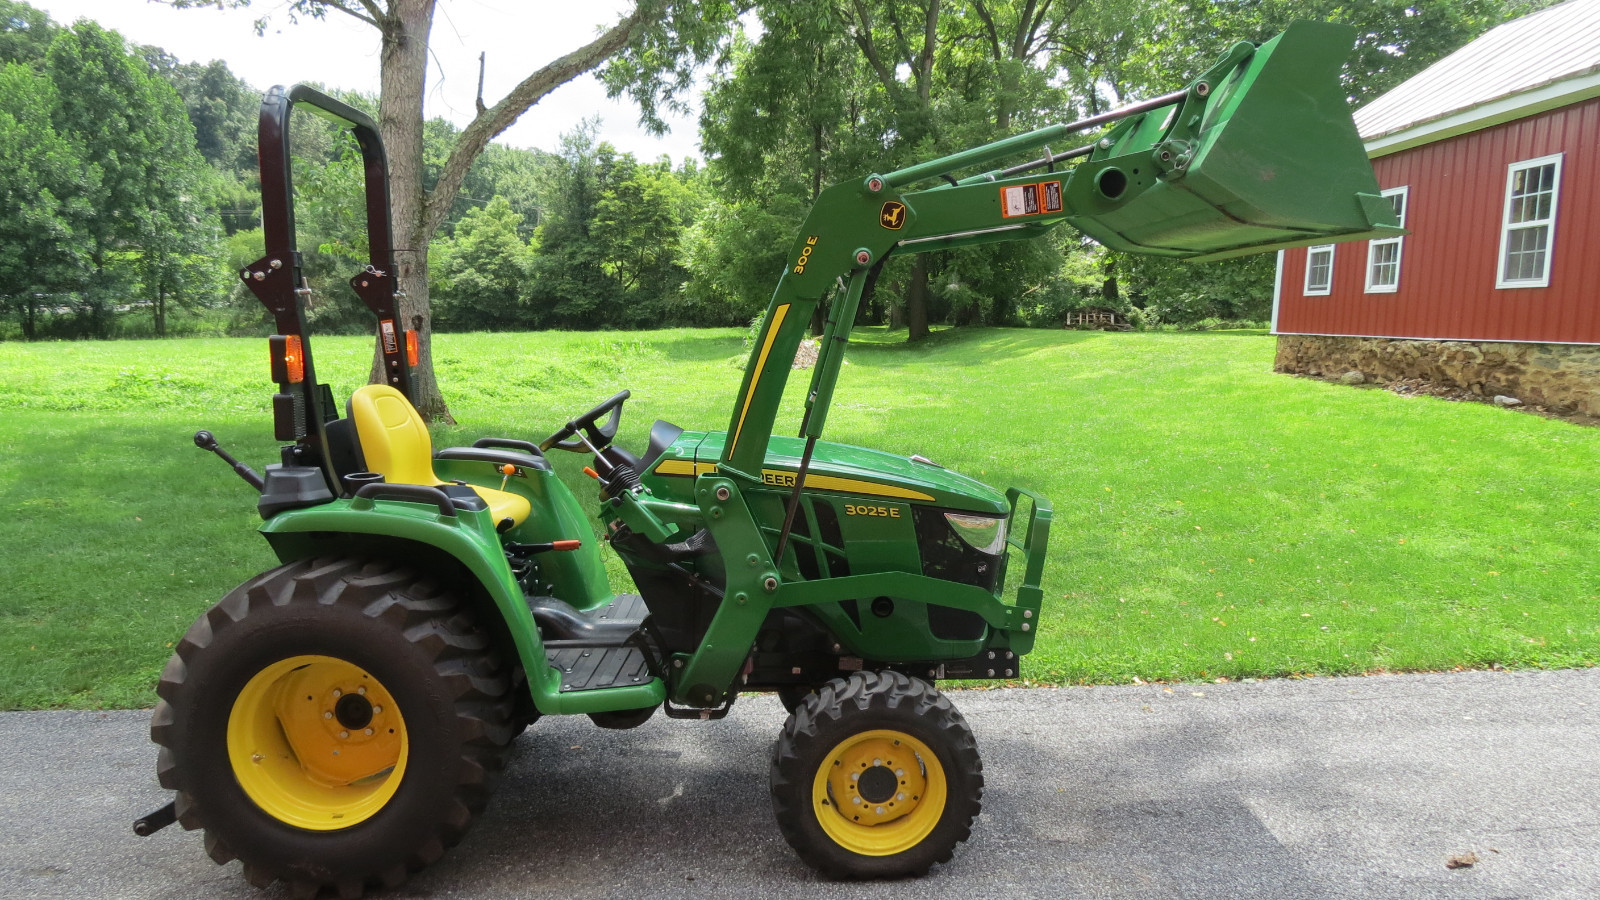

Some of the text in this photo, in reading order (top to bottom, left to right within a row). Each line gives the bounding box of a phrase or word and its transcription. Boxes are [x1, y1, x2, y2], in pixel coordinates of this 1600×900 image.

[793, 235, 819, 275] 300E
[761, 472, 797, 486] EER
[844, 504, 901, 518] 3025E
